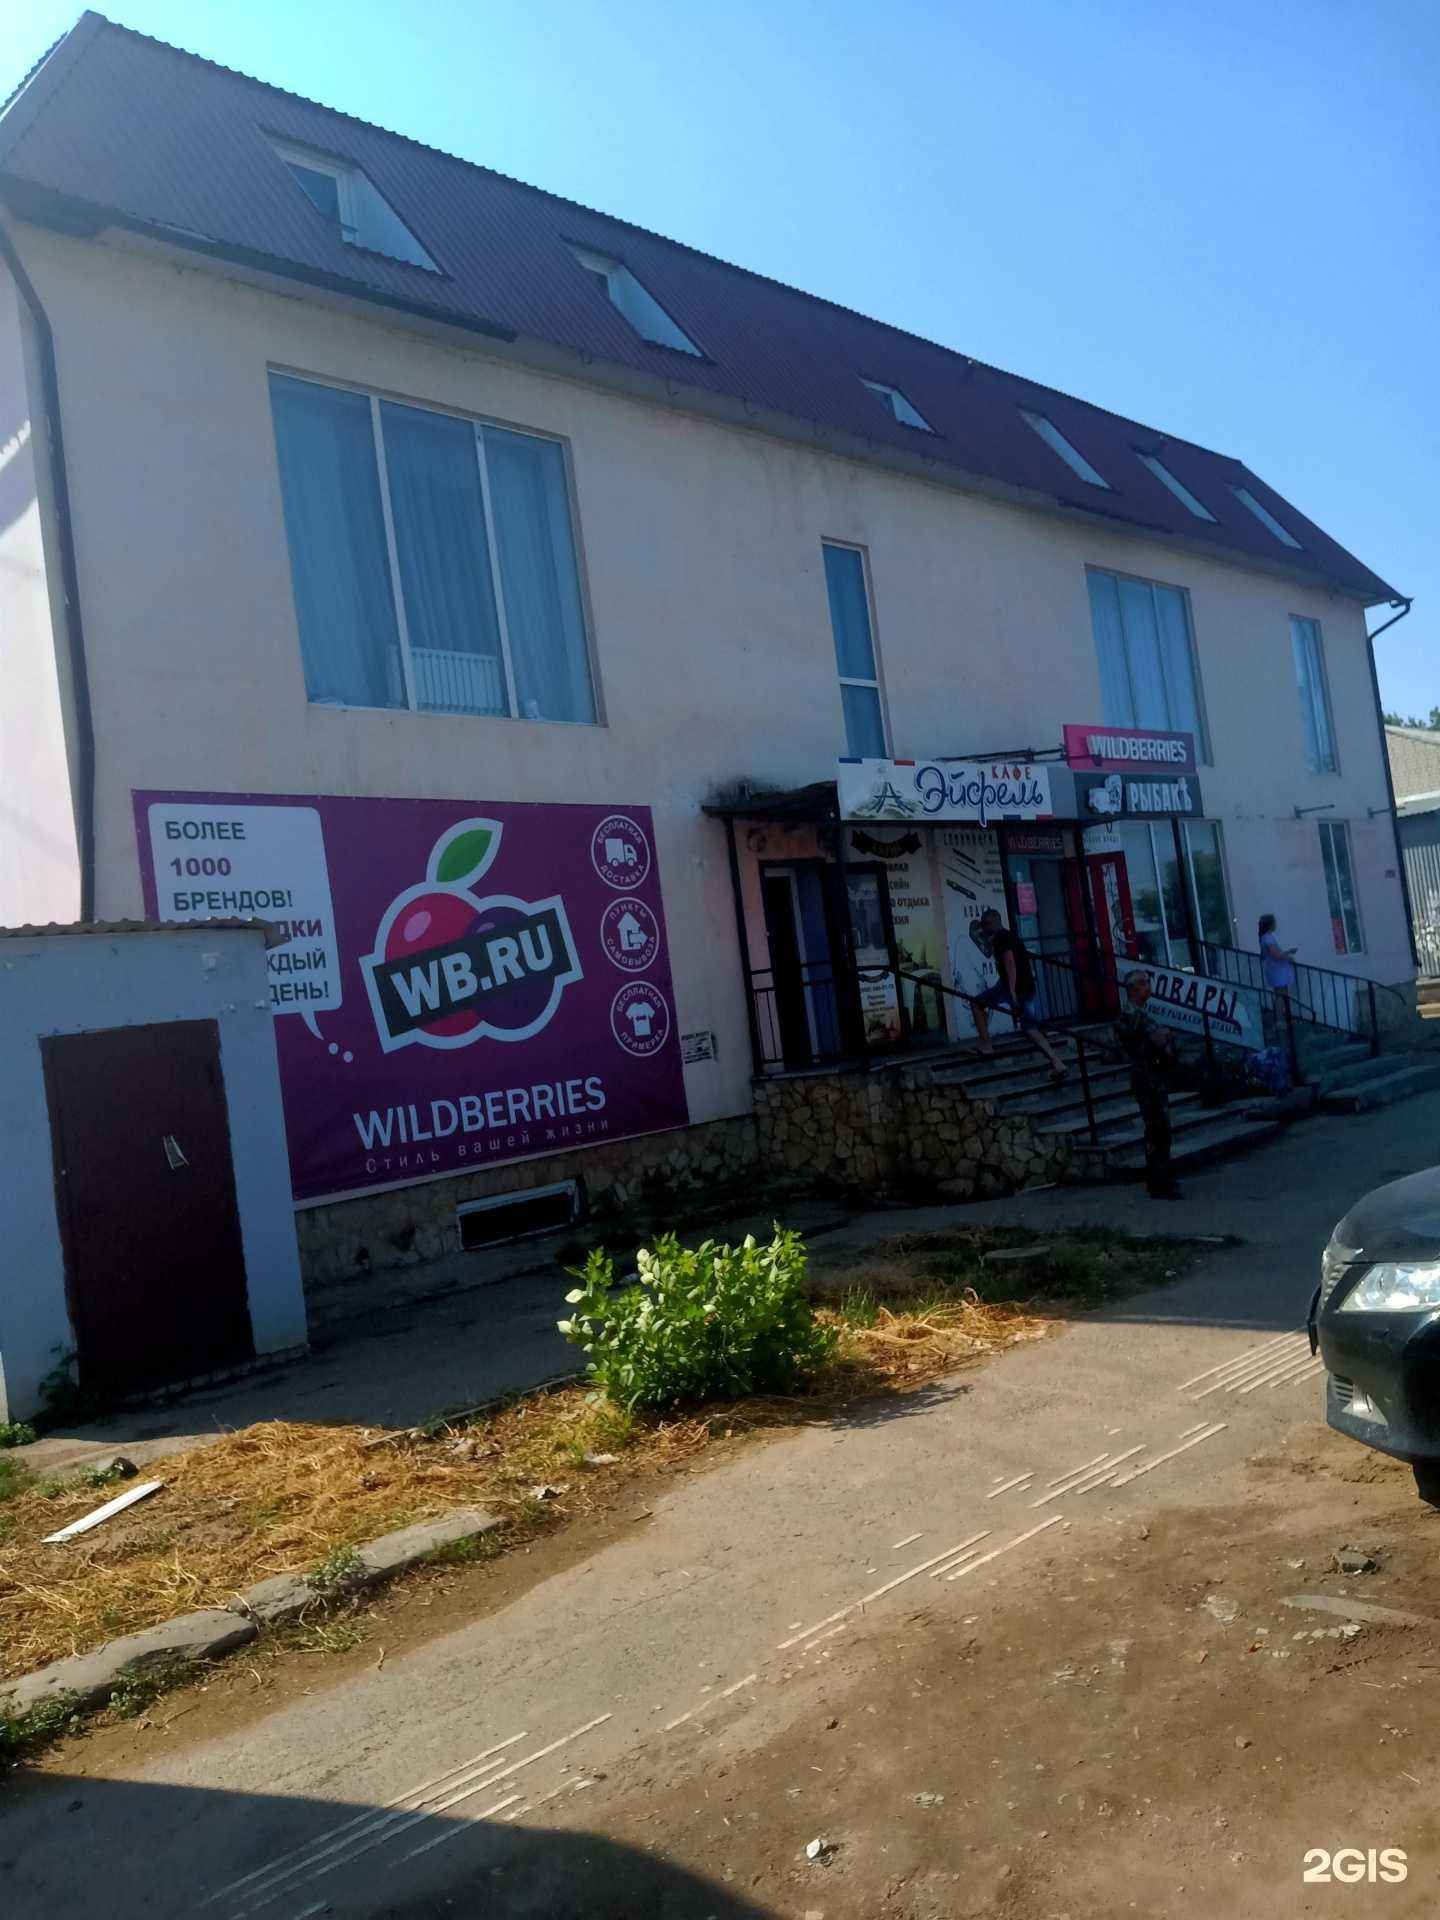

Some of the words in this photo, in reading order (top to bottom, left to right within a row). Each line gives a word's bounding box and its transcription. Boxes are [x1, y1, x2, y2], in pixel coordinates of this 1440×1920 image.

[1087, 735, 1187, 763] WILDBERRIES
[991, 765, 1032, 781] КАФЕ
[916, 766, 1044, 830] Эйфель
[165, 820, 246, 841] БОЛЕЕ
[597, 817, 644, 845] БЕСПЛАТНАЯ
[169, 857, 232, 877] 1000
[600, 863, 647, 885] ДОСТАВКА
[173, 889, 293, 913] БРЕНДОВ!
[277, 919, 323, 944] ДКИ
[390, 924, 555, 1017] WB.RU
[616, 987, 663, 1014] БЕСПЛАТНАЯ
[621, 1029, 666, 1052] ПРИМЕРКА
[353, 1076, 606, 1150] WILDBERRIES
[365, 1150, 441, 1175] Стиль
[457, 1130, 532, 1158] вашей
[545, 1118, 609, 1146] жизни
